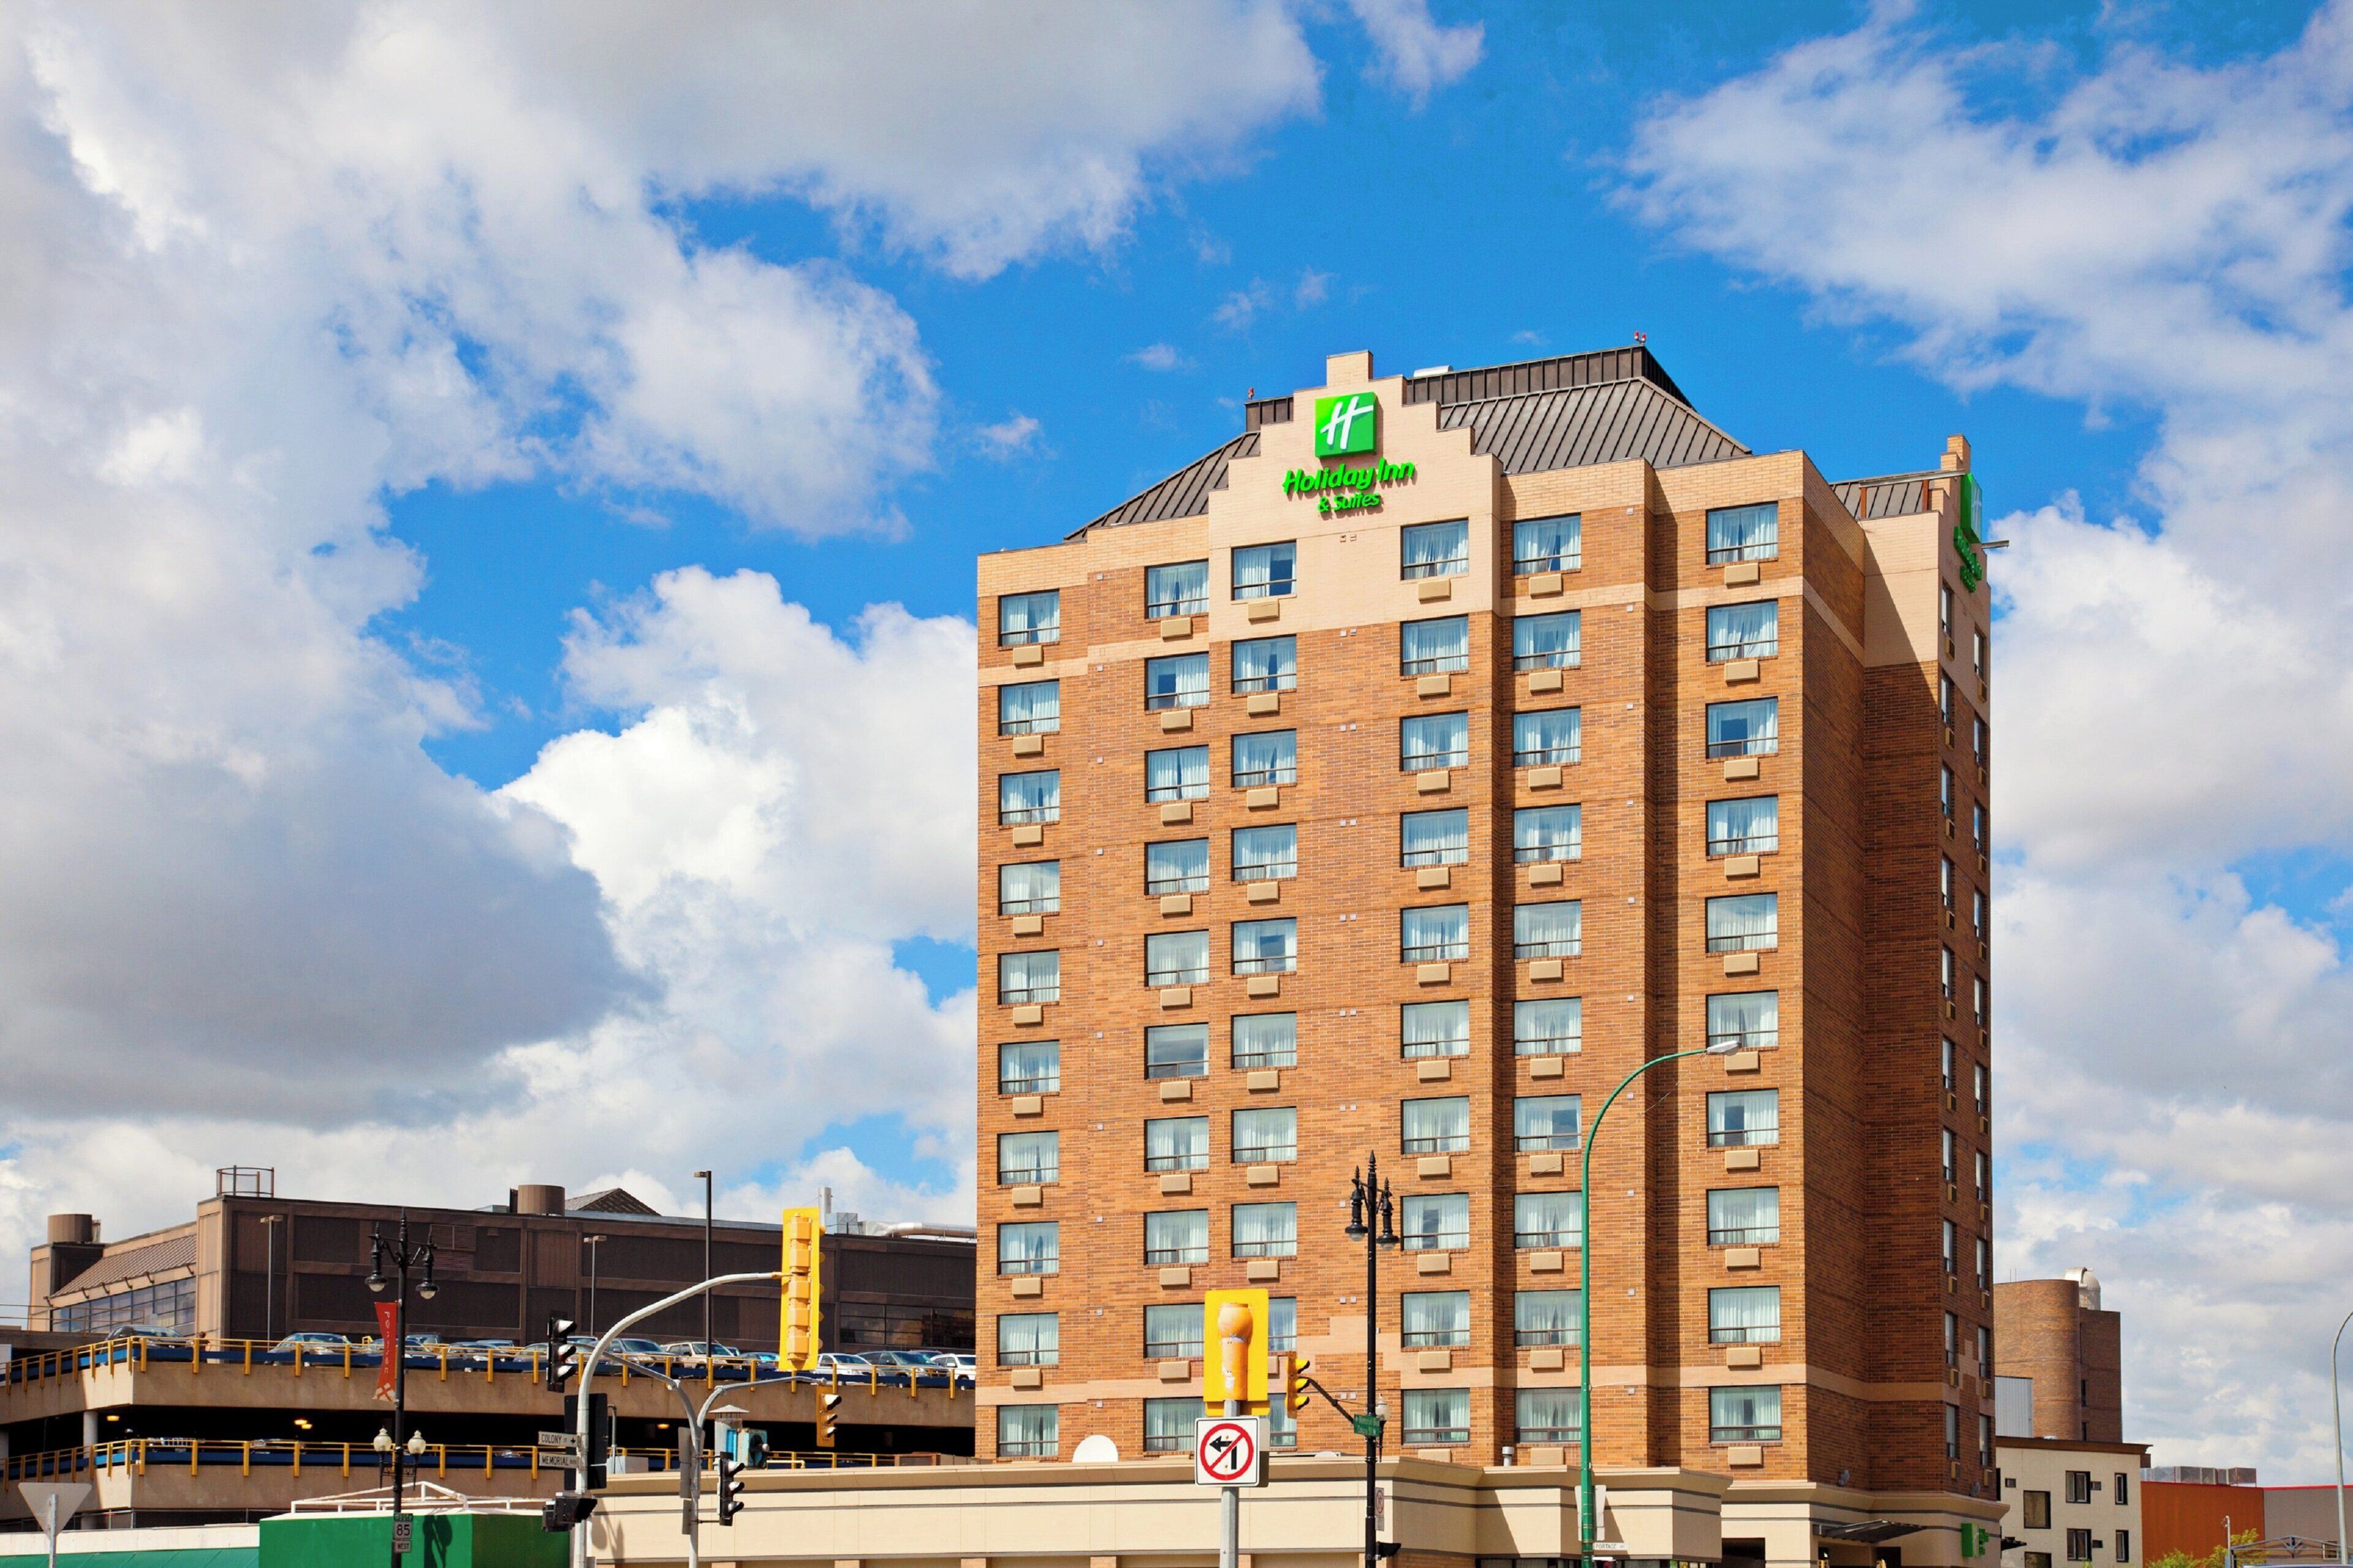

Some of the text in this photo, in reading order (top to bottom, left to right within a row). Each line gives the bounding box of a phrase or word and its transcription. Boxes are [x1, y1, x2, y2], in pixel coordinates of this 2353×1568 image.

[1320, 396, 1374, 449] H
[1283, 457, 1415, 493] Holiday Inn
[1317, 491, 1381, 512] & Suites
[542, 1434, 562, 1444] COLONY
[542, 1455, 569, 1466] MEMORIAL
[396, 1524, 410, 1536] 85
